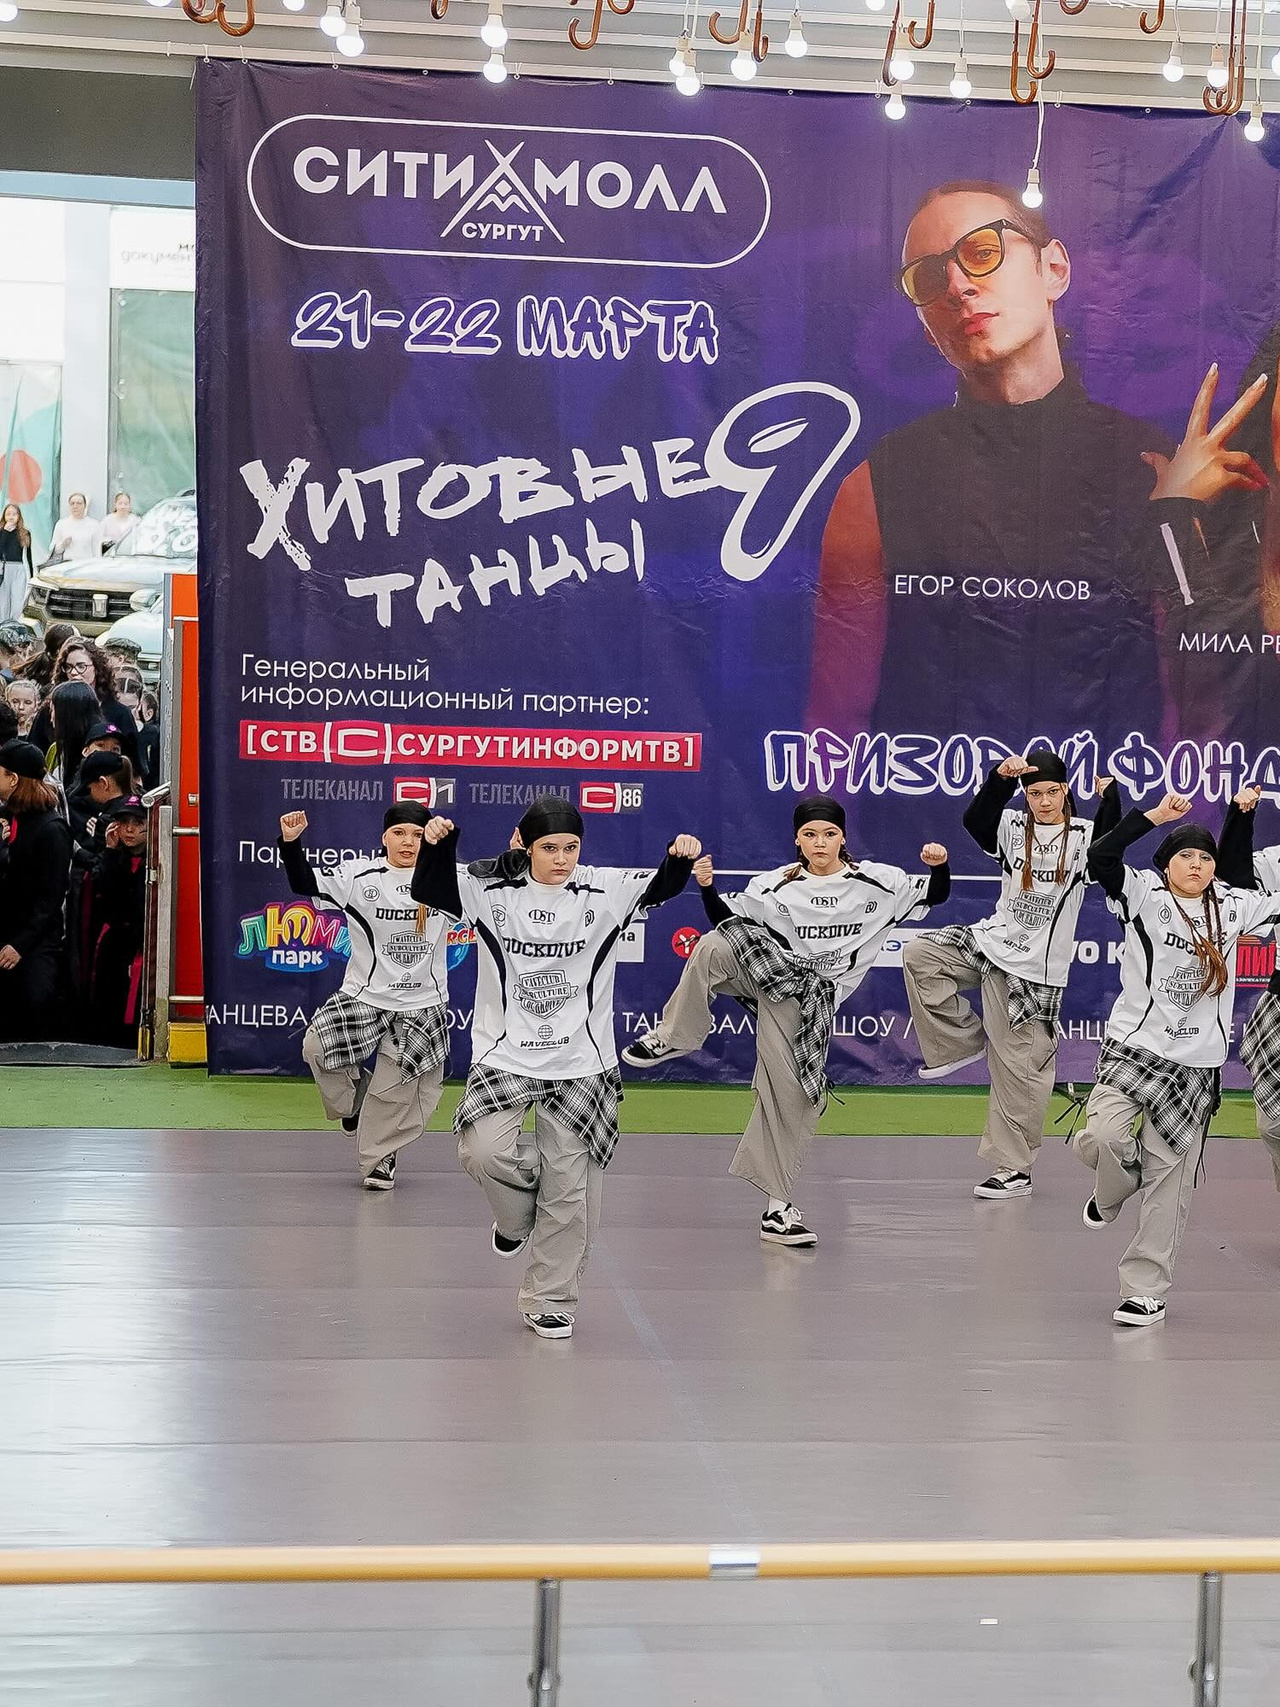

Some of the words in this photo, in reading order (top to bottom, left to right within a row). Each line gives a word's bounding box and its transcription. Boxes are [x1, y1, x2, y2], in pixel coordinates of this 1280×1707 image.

[461, 222, 545, 242] СУРГУТ
[291, 289, 501, 355] 21-22
[517, 295, 719, 364] МАРТА
[239, 438, 710, 571] ХИТОВЫЕ
[345, 518, 646, 627] ТАНЦЫ
[894, 574, 955, 597] ЕГОР
[962, 576, 1091, 601] СОКОЛОВ
[1178, 632, 1254, 655] МИЛА
[241, 653, 430, 684] Генеральный
[241, 682, 513, 711] информационный
[523, 693, 649, 719] партнер:
[281, 778, 383, 801] ТЕЛЕКАНАЛ
[795, 922, 863, 940] UCKDIVE
[271, 949, 324, 966] парк
[831, 1014, 896, 1037] ШОУ
[520, 1036, 570, 1049] WAVECLUB
